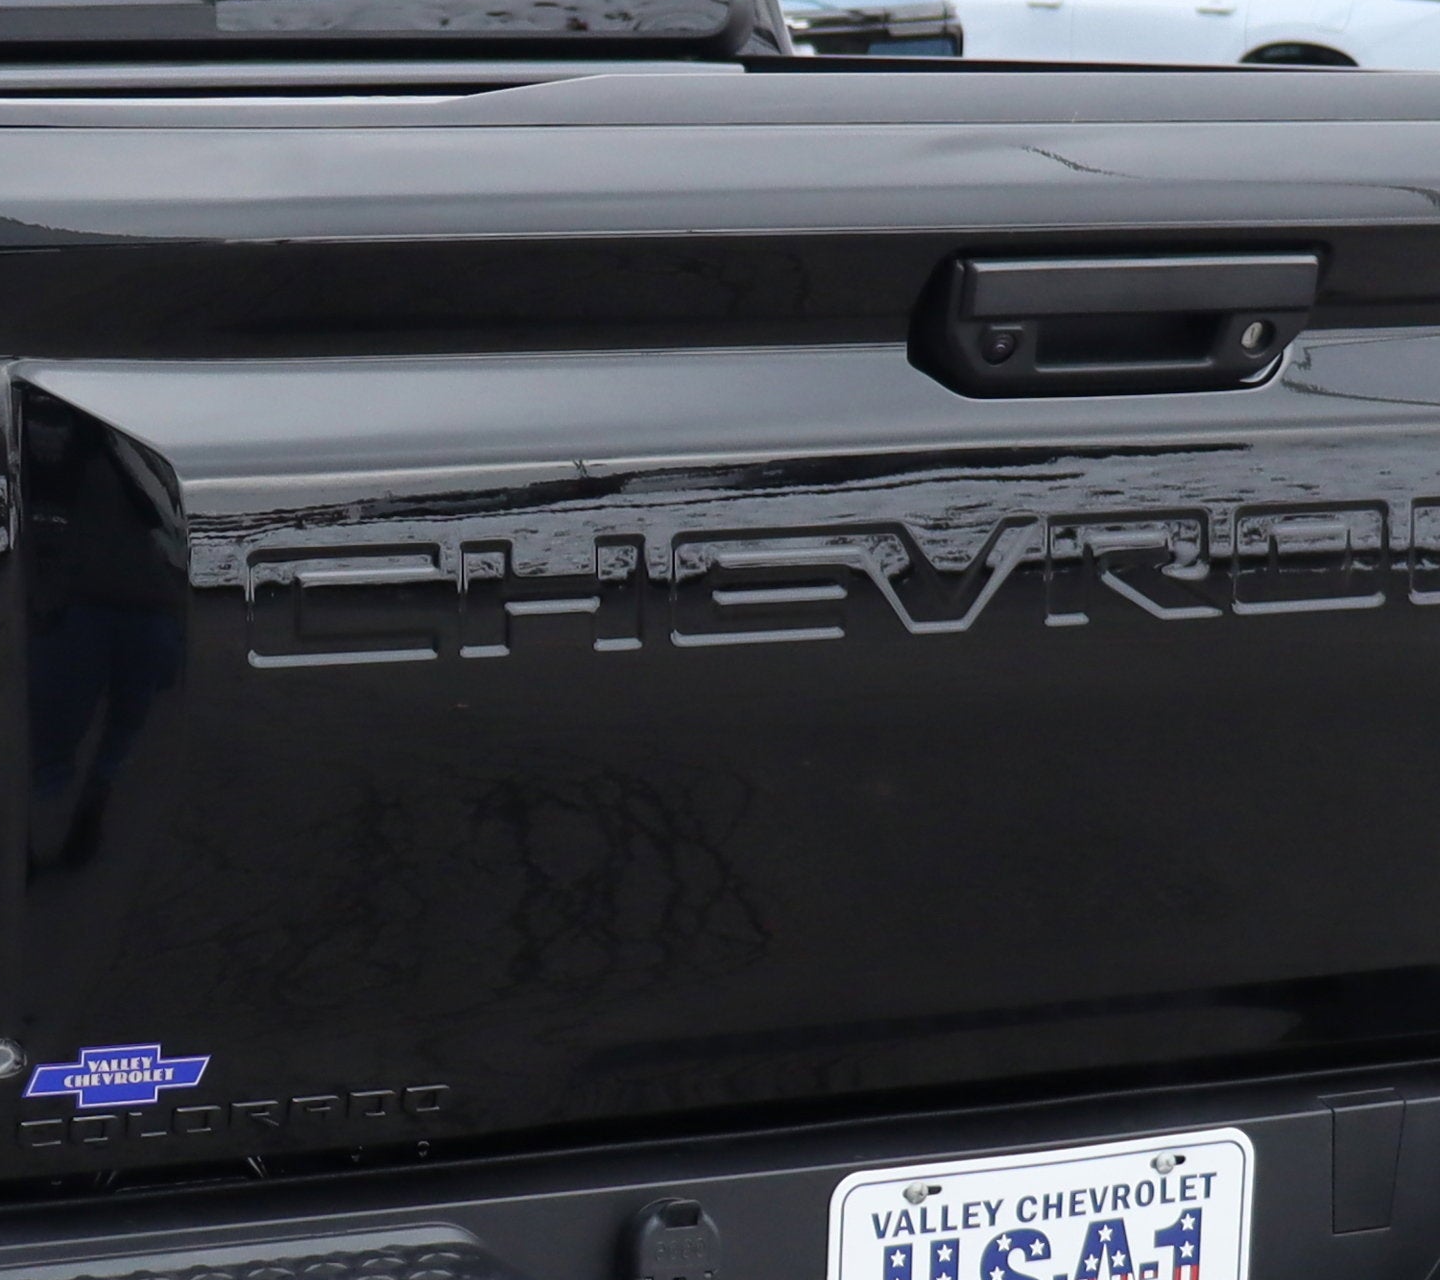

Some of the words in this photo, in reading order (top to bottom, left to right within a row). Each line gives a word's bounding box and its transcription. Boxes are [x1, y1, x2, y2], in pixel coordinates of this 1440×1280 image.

[63, 1067, 175, 1089] CHEVROLET
[87, 1055, 154, 1073] VALLEY
[16, 1083, 452, 1148] COLORADO
[871, 1198, 1004, 1239] VALLEY
[1015, 1171, 1218, 1223] CHEVROLET
